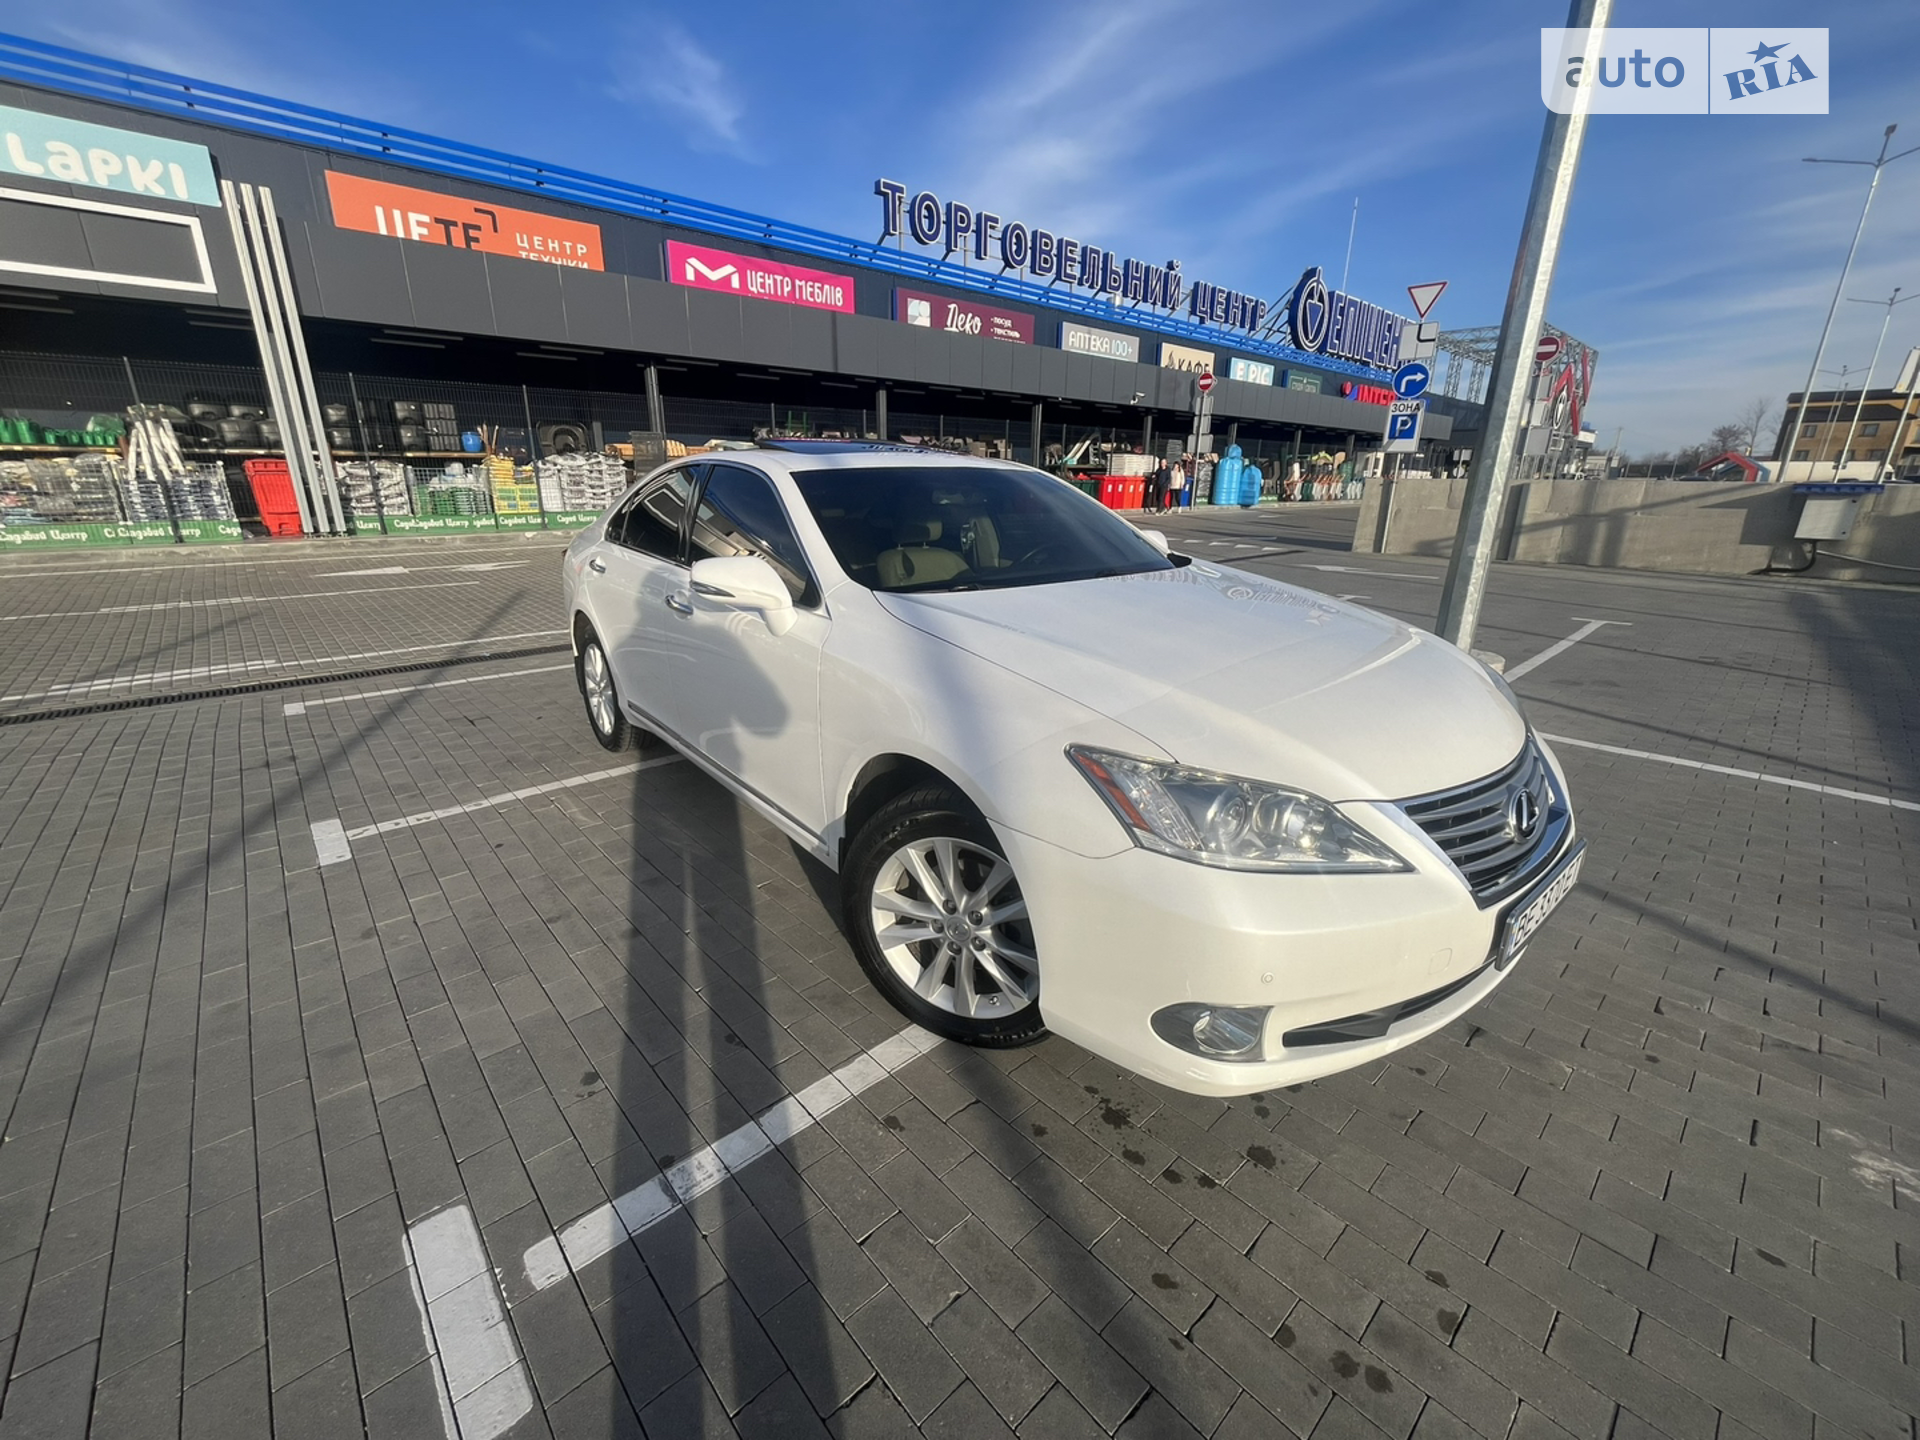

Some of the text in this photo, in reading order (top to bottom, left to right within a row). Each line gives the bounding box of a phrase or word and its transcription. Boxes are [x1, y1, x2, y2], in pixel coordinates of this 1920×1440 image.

[515, 232, 588, 257] ЦЕНТР
[874, 177, 1269, 332] ТОРГОВЕЛЬНИЙ ЦЕНТР
[746, 268, 844, 307] ЦЕНТР МЕБЛІВ
[1068, 330, 1110, 350] АПТЕКА
[1391, 402, 1421, 413] ЗОНА
